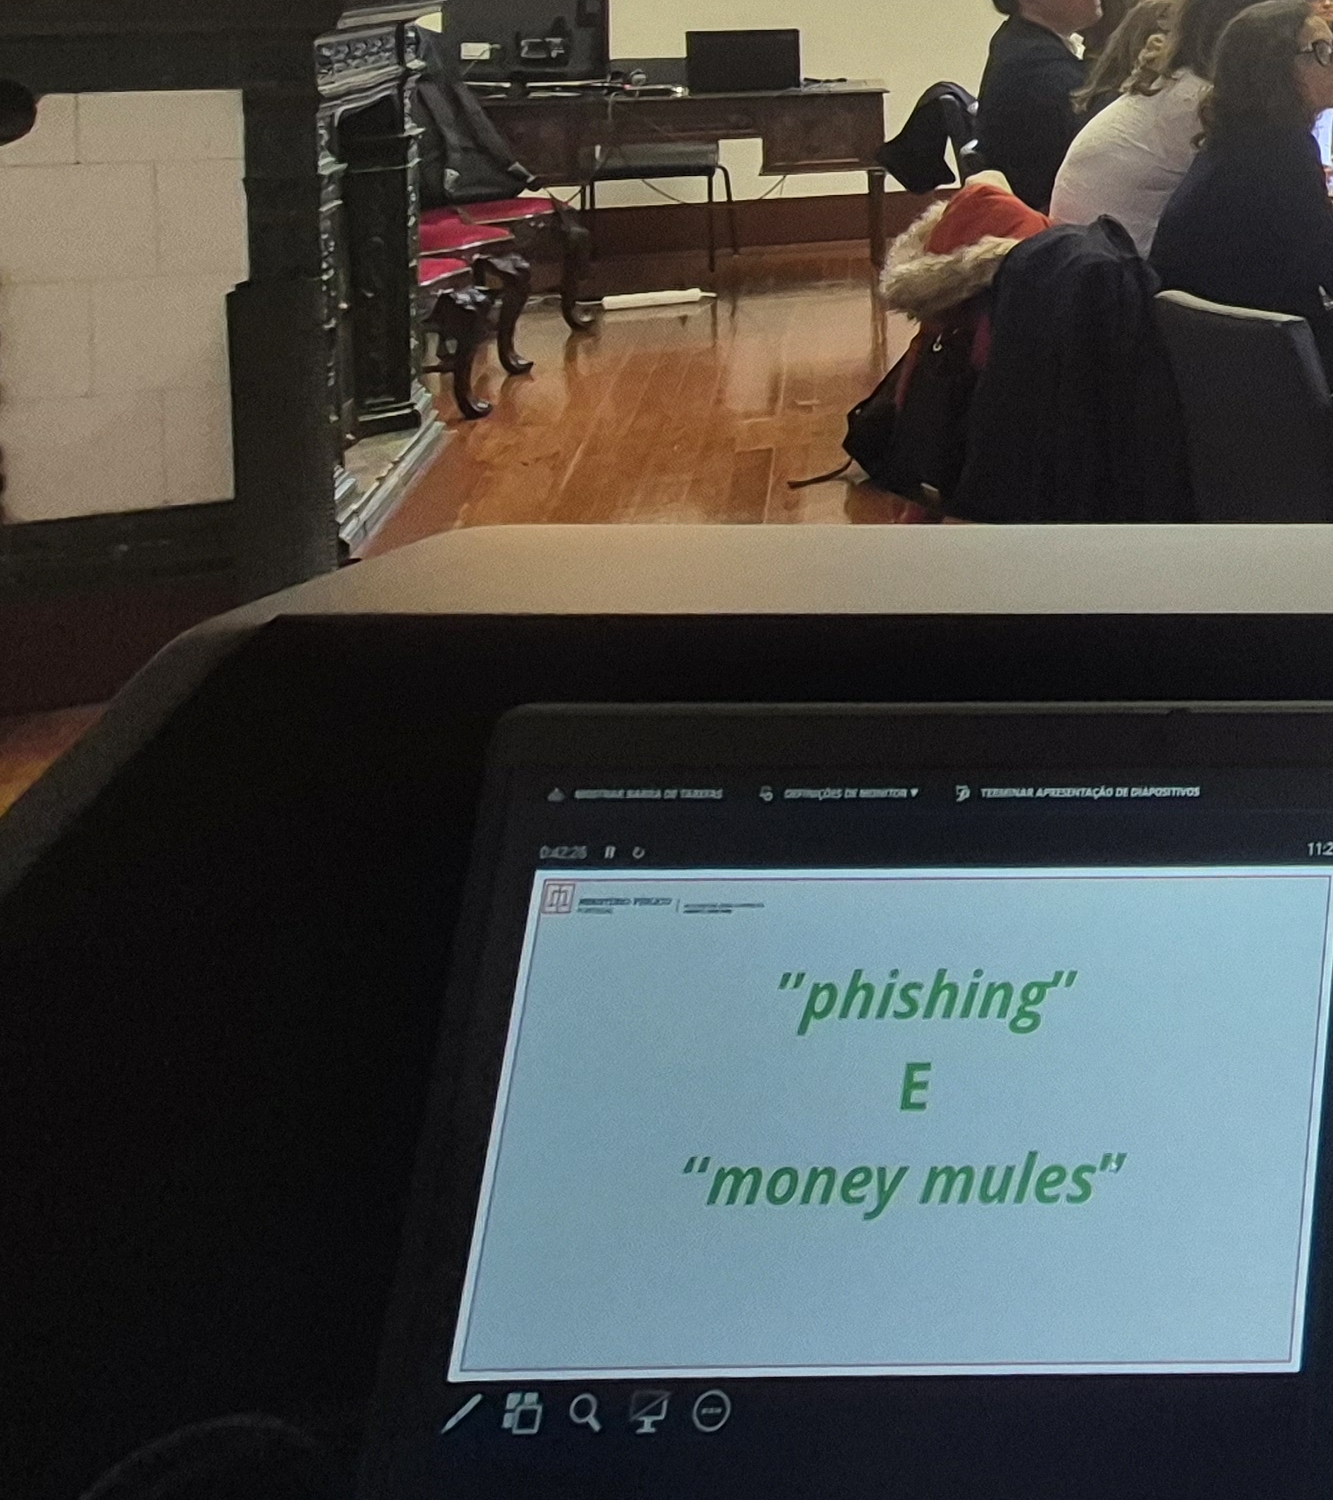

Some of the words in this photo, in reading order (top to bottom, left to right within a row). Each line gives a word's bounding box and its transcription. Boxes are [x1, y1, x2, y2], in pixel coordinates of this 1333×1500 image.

[1035, 785, 1114, 800] APRESENTAÇÃO
[1115, 786, 1129, 798] DE
[1130, 786, 1201, 798] DIAPOSITIVOS
[900, 1061, 933, 1112] E
